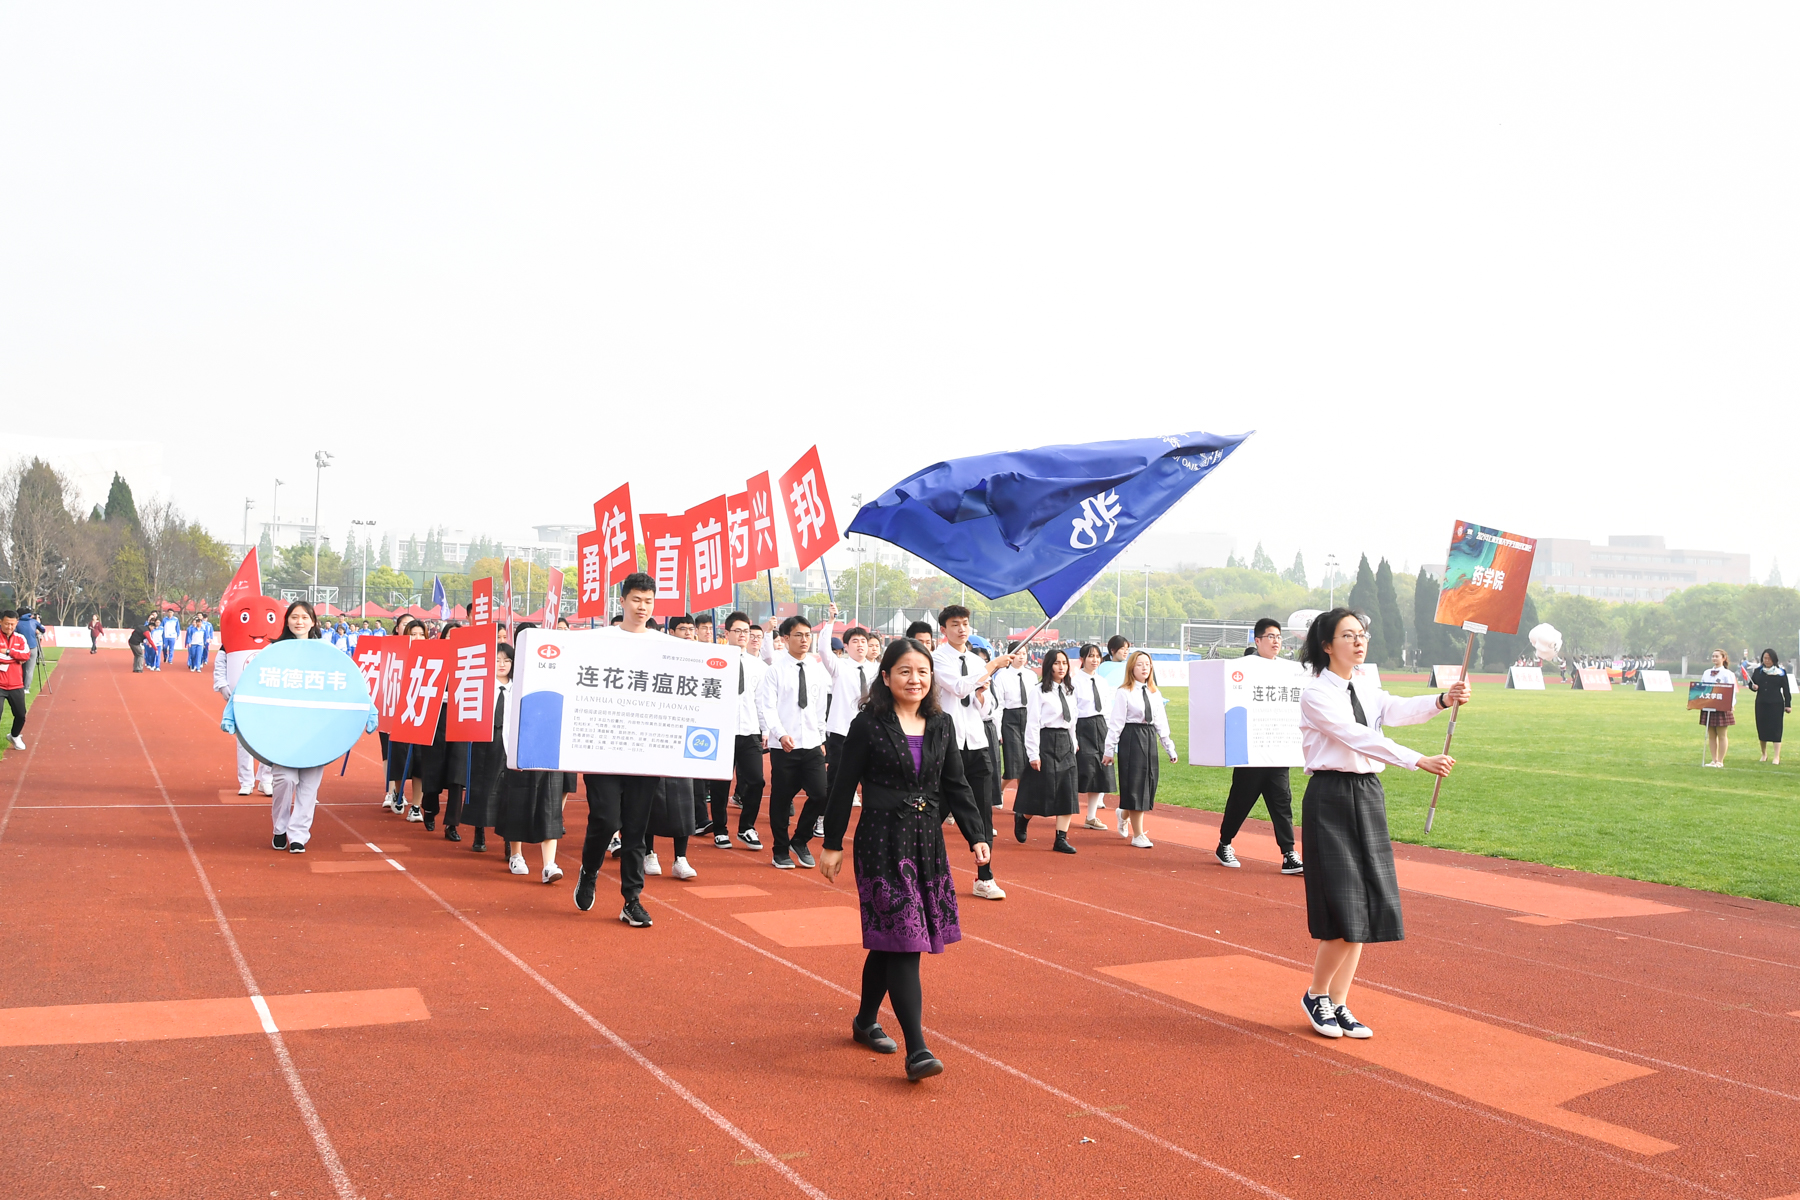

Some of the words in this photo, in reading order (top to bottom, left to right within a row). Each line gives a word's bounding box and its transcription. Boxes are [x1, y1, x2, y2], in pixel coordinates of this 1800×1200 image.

[601, 504, 631, 572] 往
[728, 507, 750, 569] 药
[752, 489, 774, 556] 兴
[789, 467, 826, 550] 邦
[582, 543, 600, 604] 勇
[654, 533, 682, 600] 直
[691, 517, 723, 595] 前
[1471, 564, 1506, 592] 药学院
[258, 666, 348, 691] 瑞德西韦
[382, 651, 404, 718] 你
[400, 655, 444, 727] 好
[454, 643, 488, 723] 看
[575, 665, 722, 700] 连花清瘟胶囊
[709, 659, 725, 667] OTC
[1252, 685, 1304, 703] 连花清瘟
[575, 695, 614, 705] LIANHUA
[616, 698, 656, 708] QINGWEN
[658, 702, 701, 713] JIAONANG
[1698, 692, 1724, 701] 人文学院
